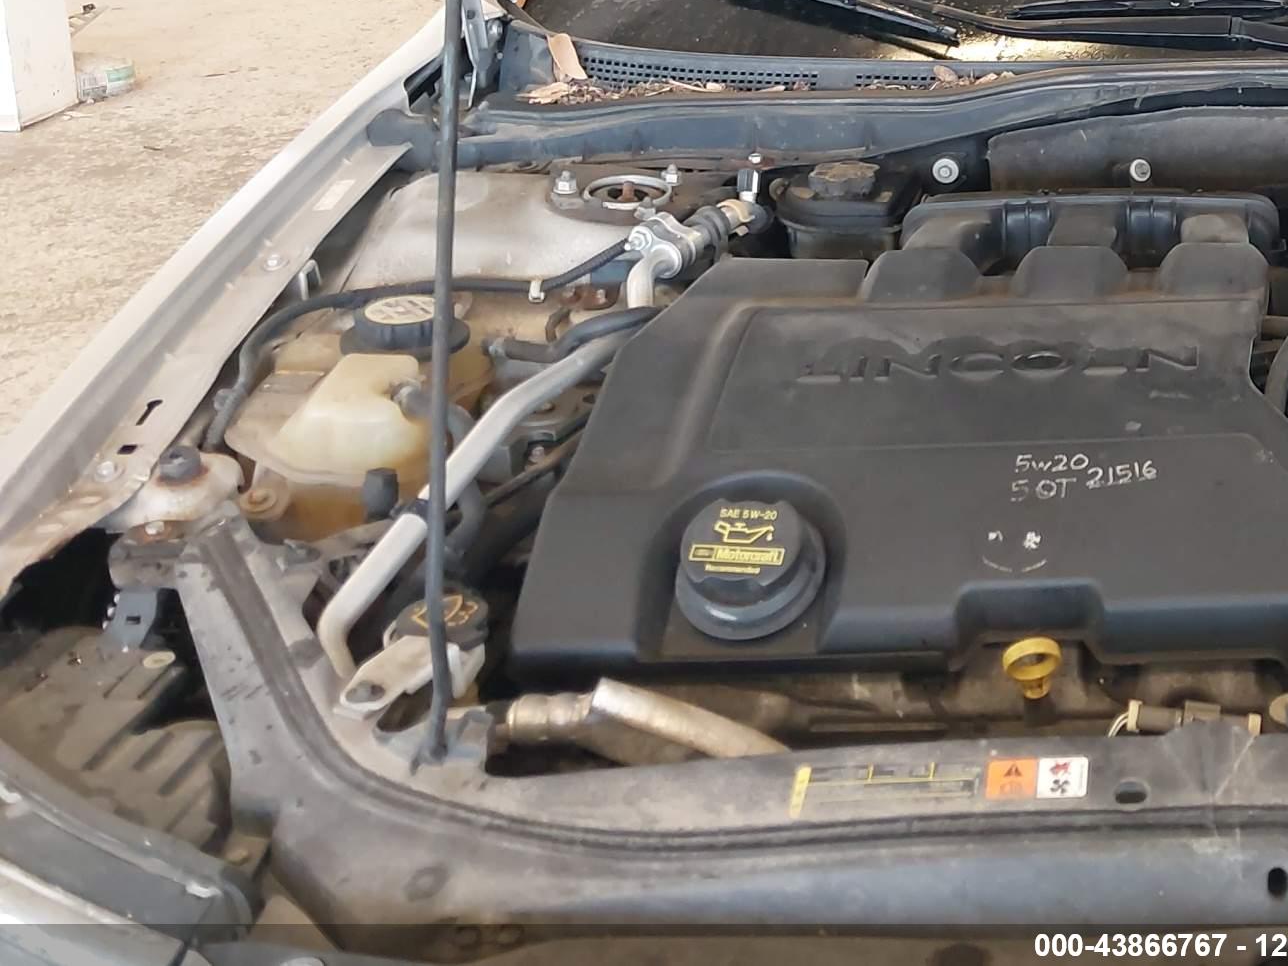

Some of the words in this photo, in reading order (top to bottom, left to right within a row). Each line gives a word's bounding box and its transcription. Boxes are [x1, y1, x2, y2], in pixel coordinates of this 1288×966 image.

[796, 344, 1198, 384] LINCOLN
[1086, 460, 1157, 489] 21516
[719, 508, 740, 518] SAE
[742, 509, 778, 521] 5W-20
[716, 547, 779, 563] Motorcraft
